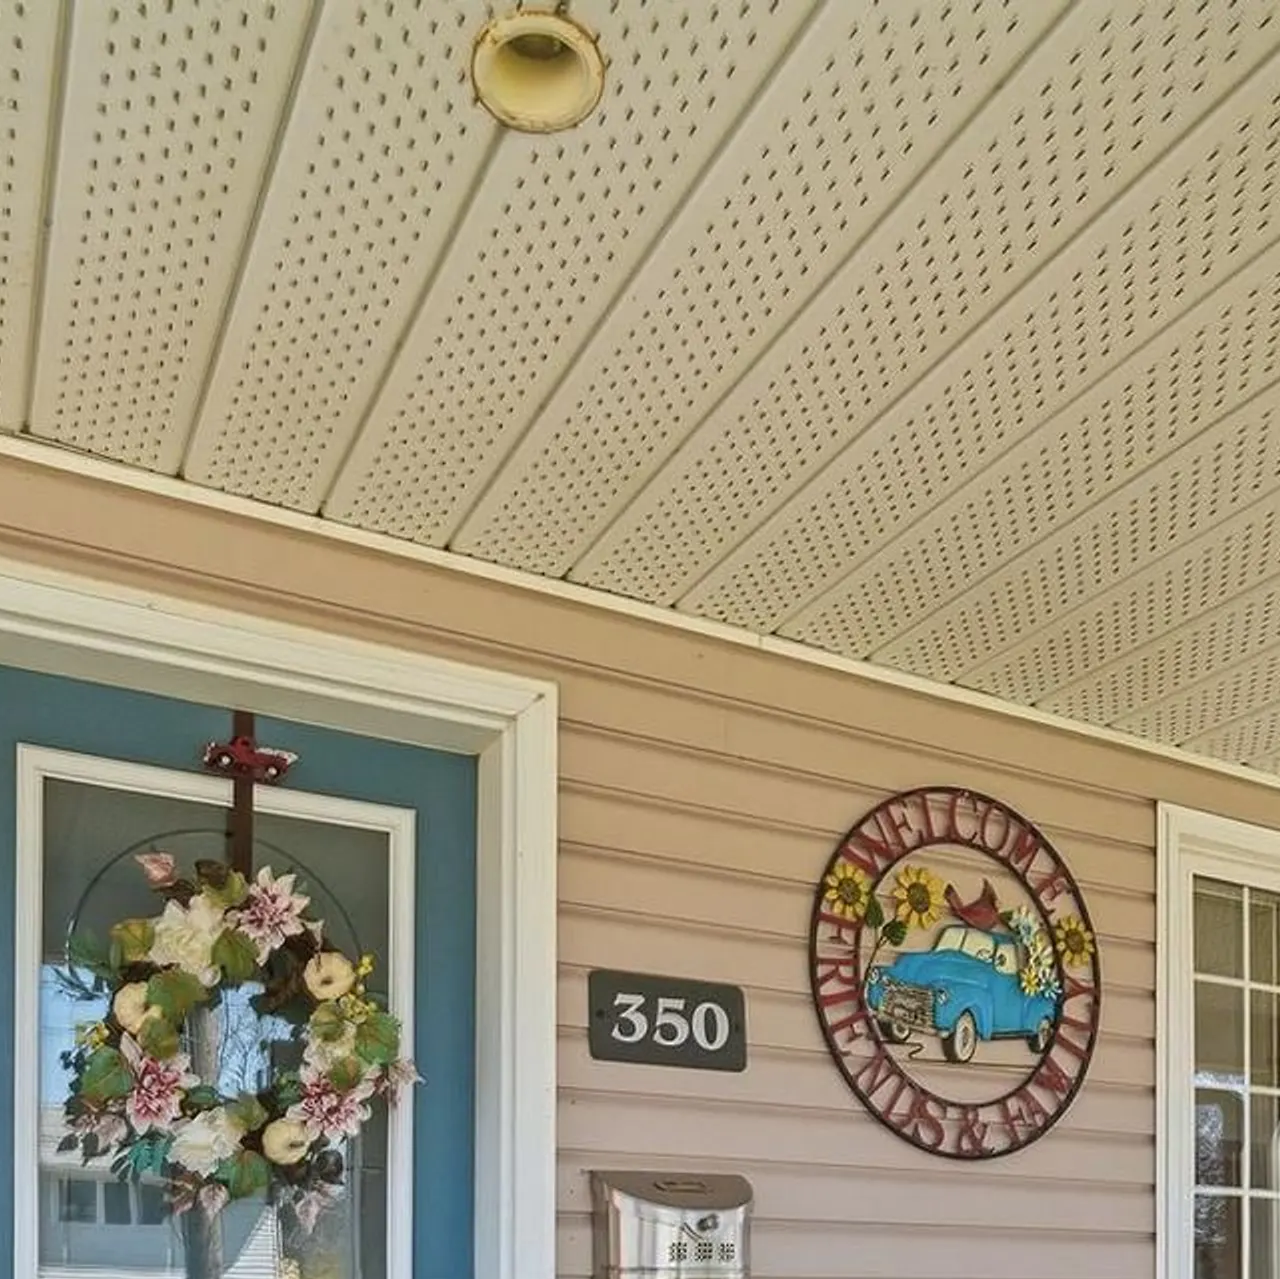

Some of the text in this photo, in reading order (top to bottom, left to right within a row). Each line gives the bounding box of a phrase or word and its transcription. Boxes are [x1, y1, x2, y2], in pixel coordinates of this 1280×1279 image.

[839, 789, 1074, 916] WELCOME
[611, 992, 730, 1051] 350
[816, 911, 1096, 1156] FRIENDS & FAMILY
